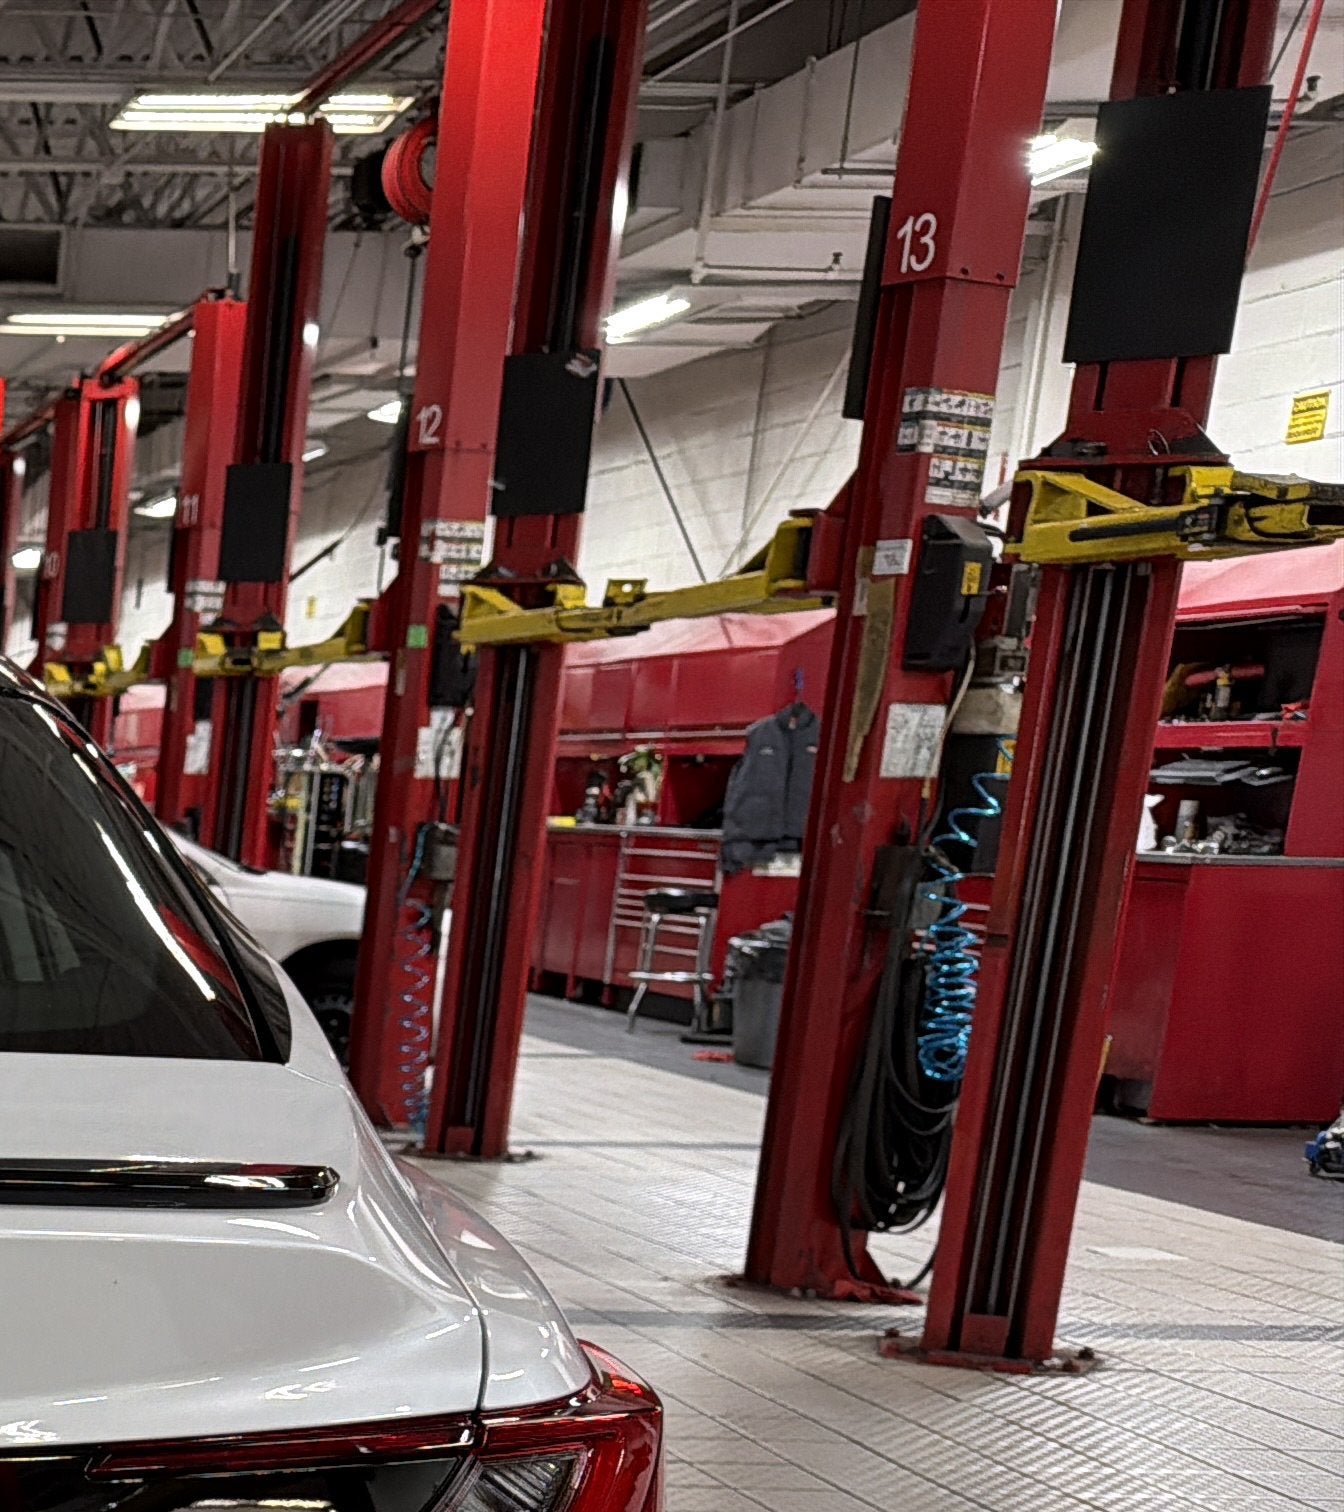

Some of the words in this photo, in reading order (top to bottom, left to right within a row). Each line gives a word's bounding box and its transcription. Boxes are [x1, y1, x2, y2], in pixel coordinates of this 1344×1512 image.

[896, 211, 938, 275] 13
[415, 404, 443, 446] 12
[182, 494, 200, 526] 11
